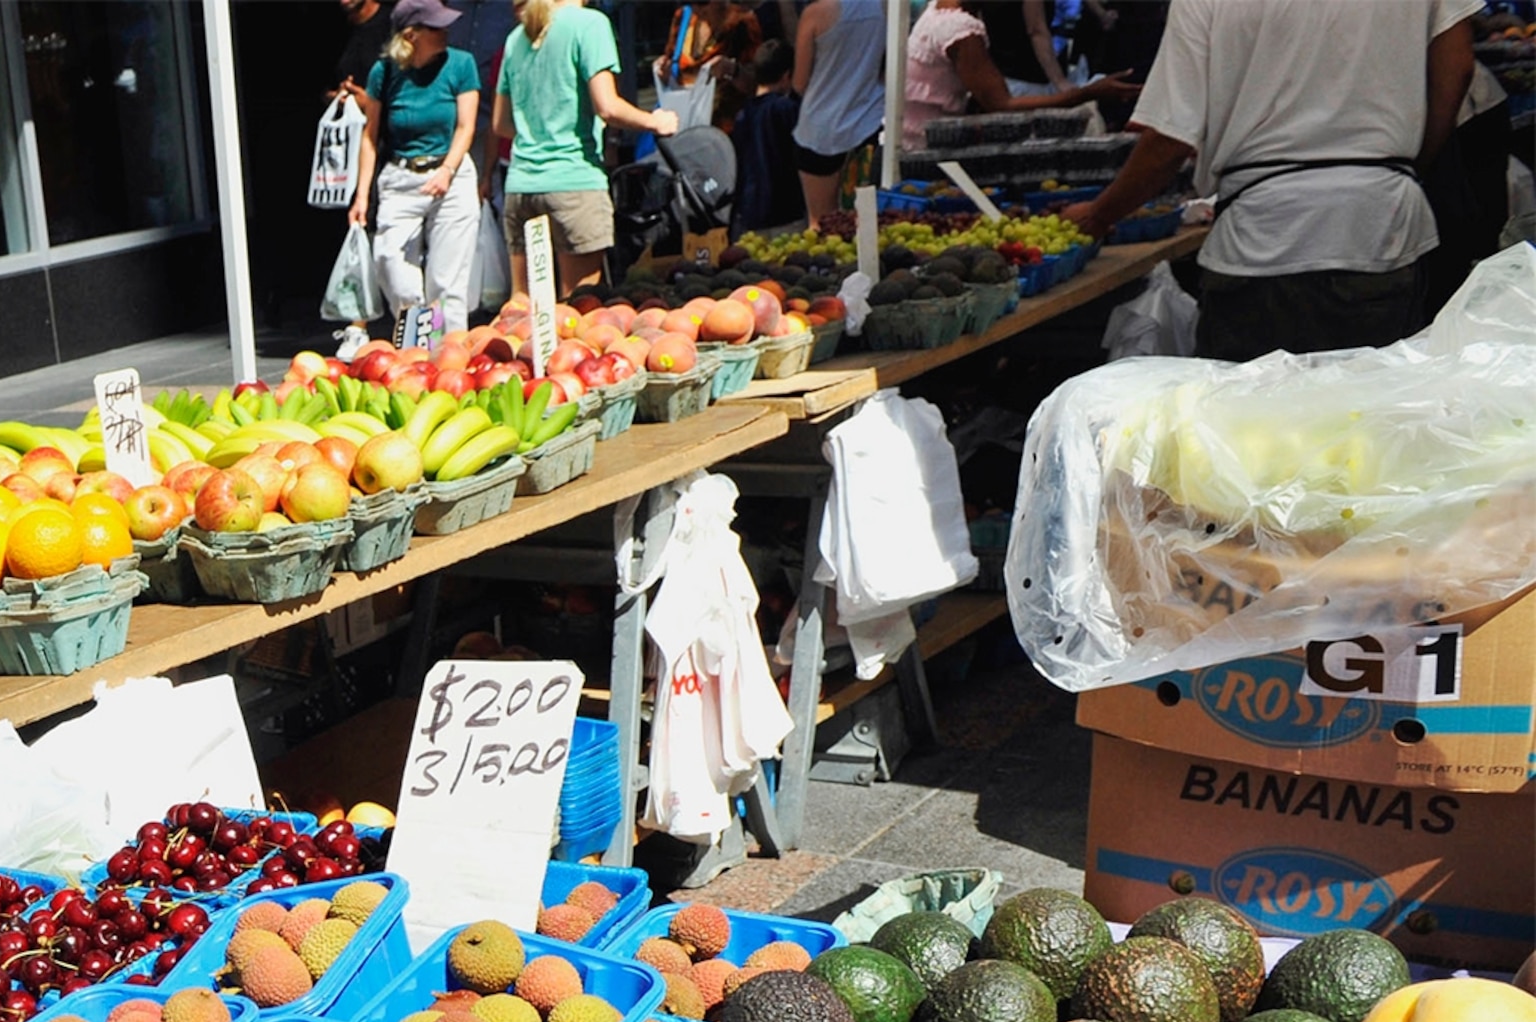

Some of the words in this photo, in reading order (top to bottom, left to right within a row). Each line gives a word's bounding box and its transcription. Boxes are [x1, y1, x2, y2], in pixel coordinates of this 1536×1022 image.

[1396, 762, 1431, 773] STORE
[1435, 765, 1453, 774] AT
[1180, 764, 1460, 834] BANANAS
[1233, 865, 1373, 922] ROSY
